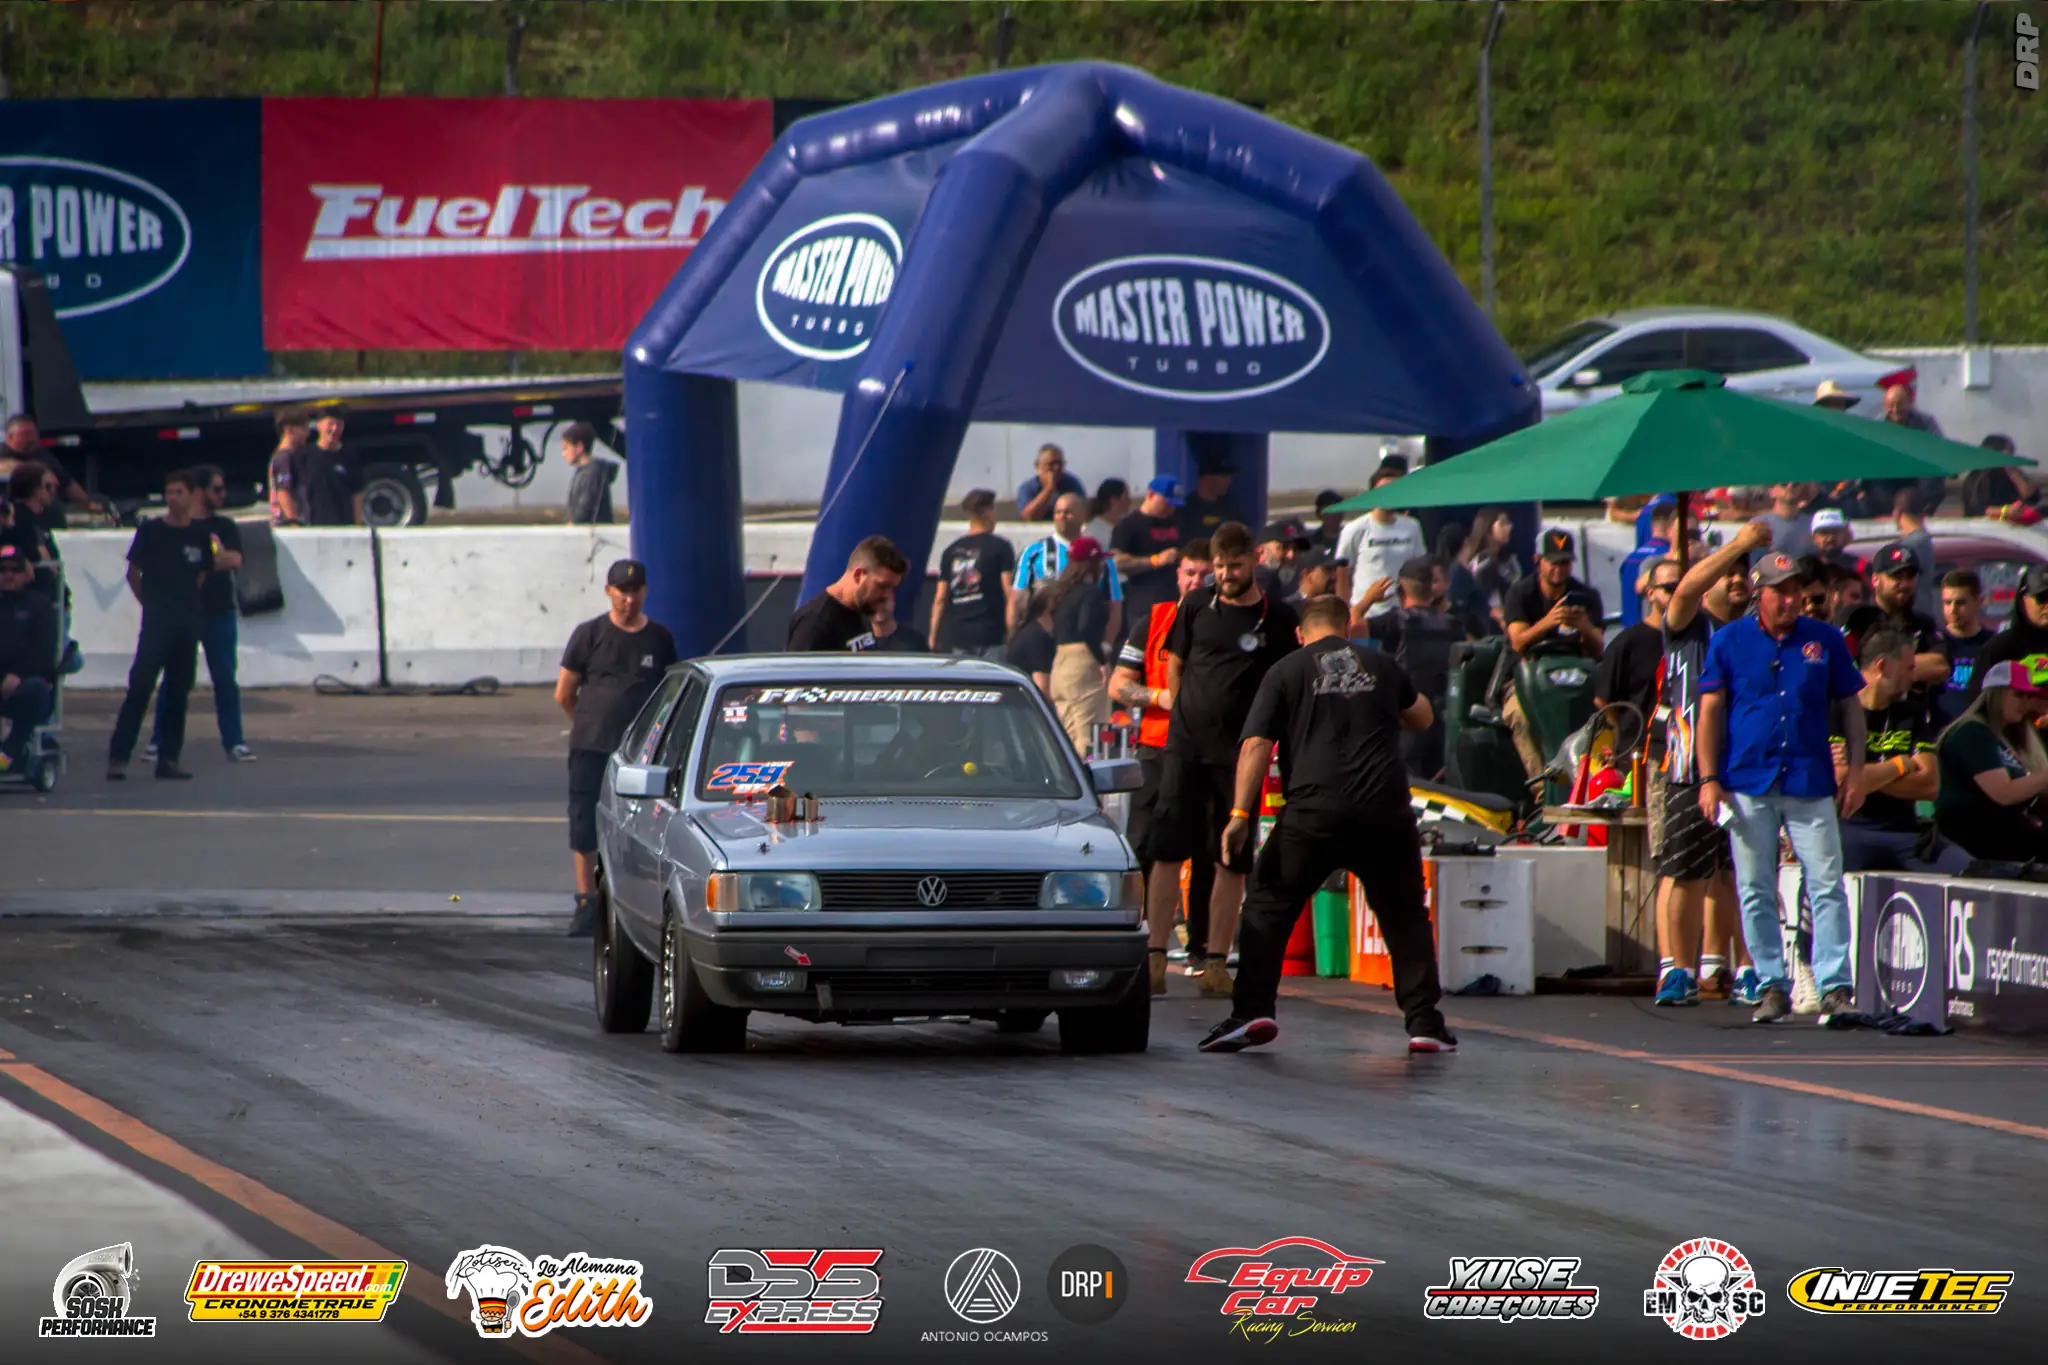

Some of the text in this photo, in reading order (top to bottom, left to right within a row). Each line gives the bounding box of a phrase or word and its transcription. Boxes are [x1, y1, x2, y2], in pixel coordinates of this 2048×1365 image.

[30, 185, 163, 260] POWER
[306, 185, 728, 240] FuelTech
[771, 235, 895, 307] MASTER POWER
[790, 313, 864, 337] TURBO
[1073, 277, 1306, 348] MASTER POWER
[1128, 356, 1261, 376] TURBO
[708, 763, 786, 787] 259
[1948, 899, 1976, 992] RS
